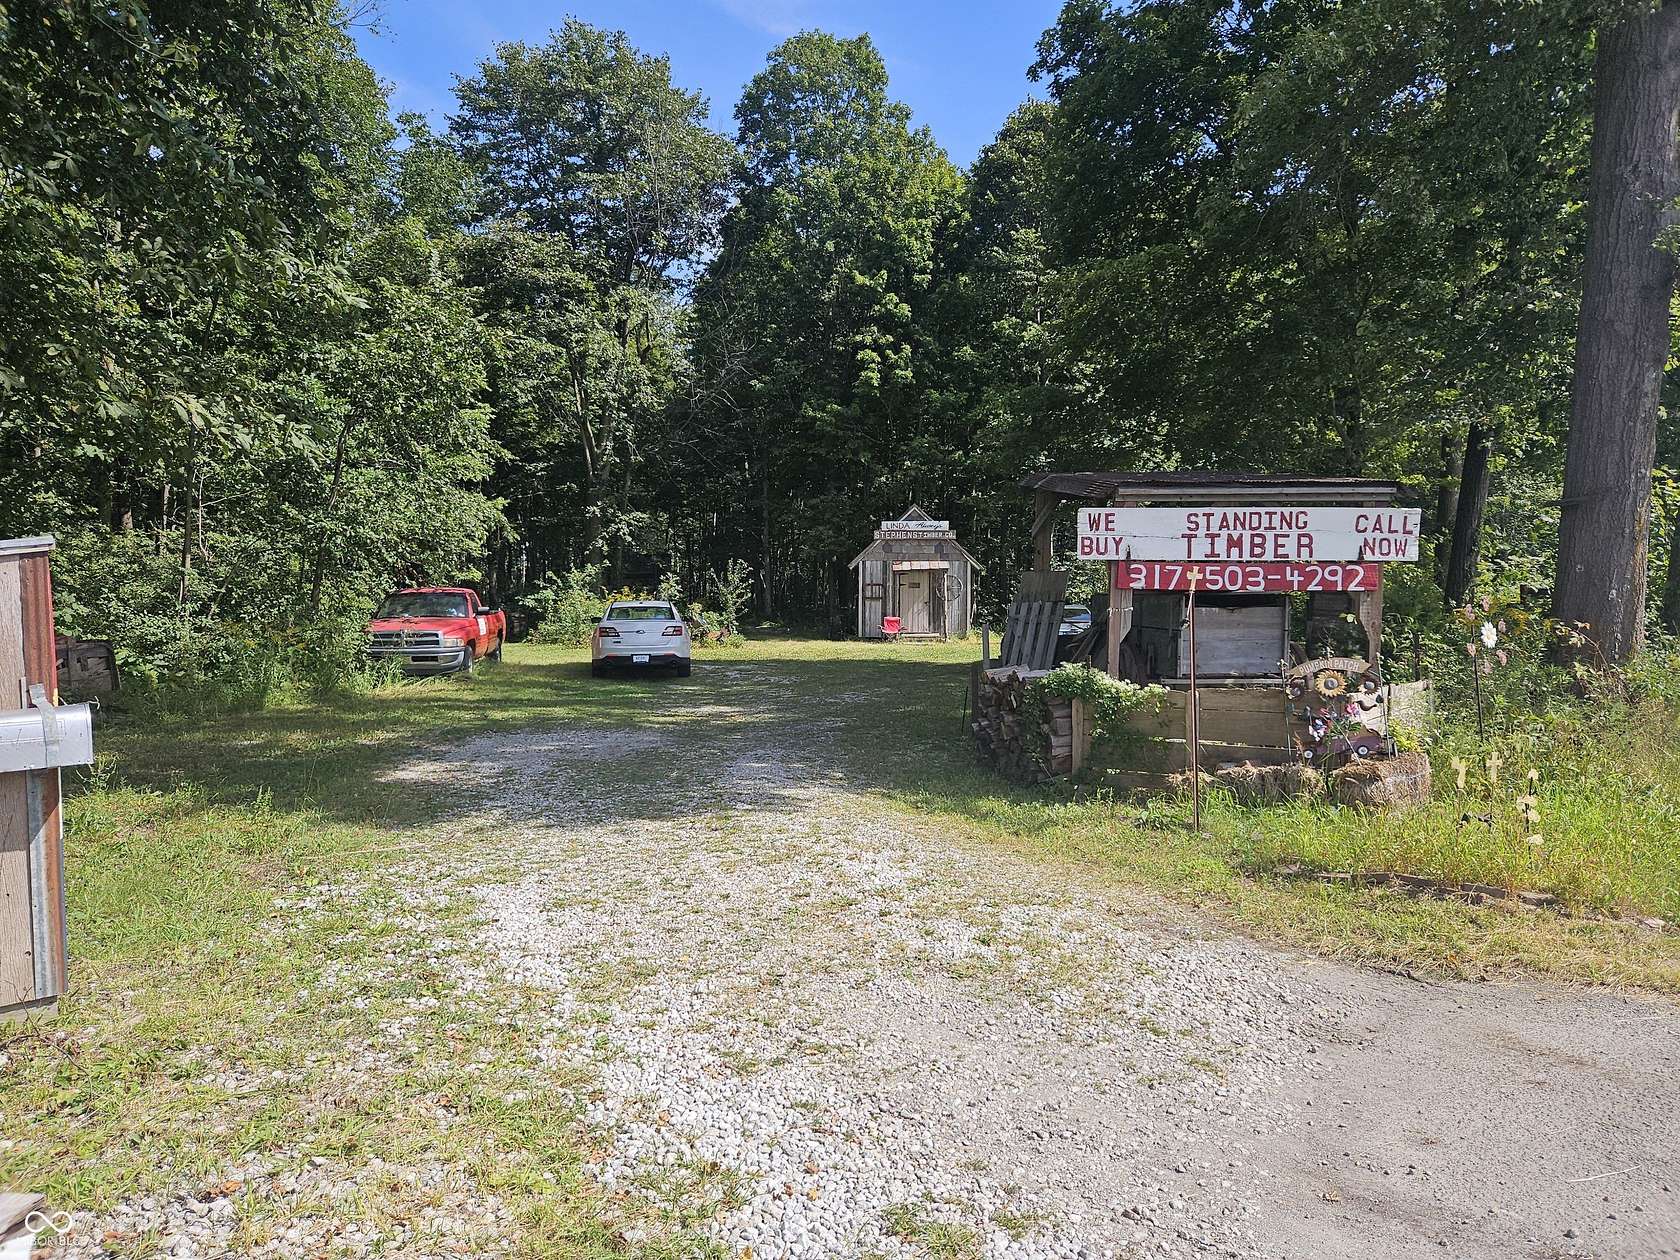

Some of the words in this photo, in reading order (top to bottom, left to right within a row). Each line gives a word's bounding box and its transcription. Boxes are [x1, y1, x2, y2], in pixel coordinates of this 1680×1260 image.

[886, 522, 911, 530] LINDA
[1087, 512, 1115, 532] WE
[1186, 510, 1308, 532] STANDING
[1355, 514, 1413, 535] CALL
[874, 531, 918, 539] STEPHENS
[1080, 536, 1124, 556] BUY
[1180, 532, 1314, 559] TIMBER
[1363, 538, 1408, 557] NOW
[1334, 659, 1360, 671] PATCH
